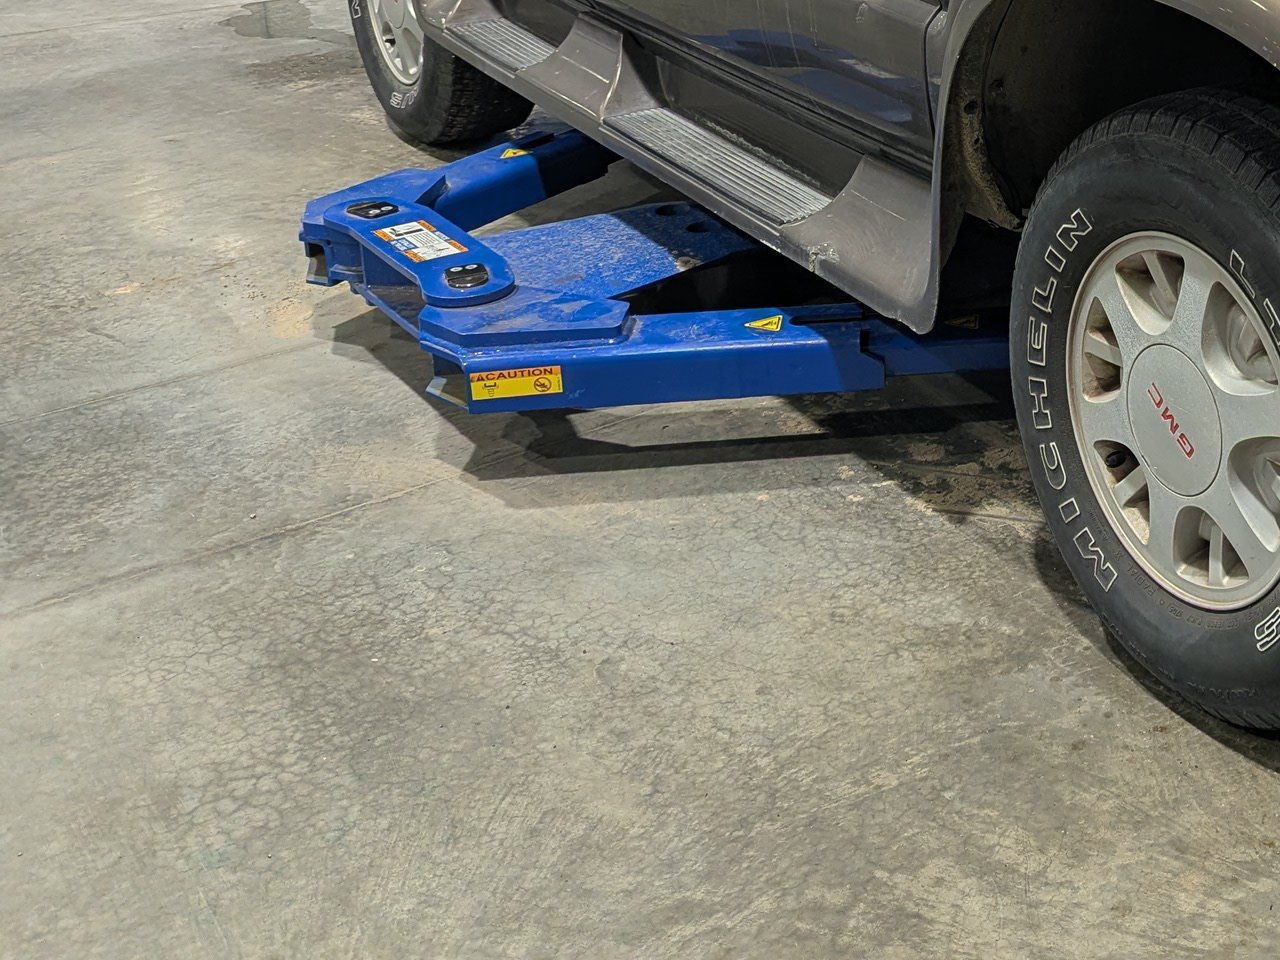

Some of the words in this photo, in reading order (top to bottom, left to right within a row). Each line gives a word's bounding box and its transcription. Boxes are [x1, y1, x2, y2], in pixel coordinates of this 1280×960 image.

[485, 368, 553, 381] CAUTION
[1027, 208, 1118, 592] MICHELIN
[1147, 382, 1196, 460] GMC
